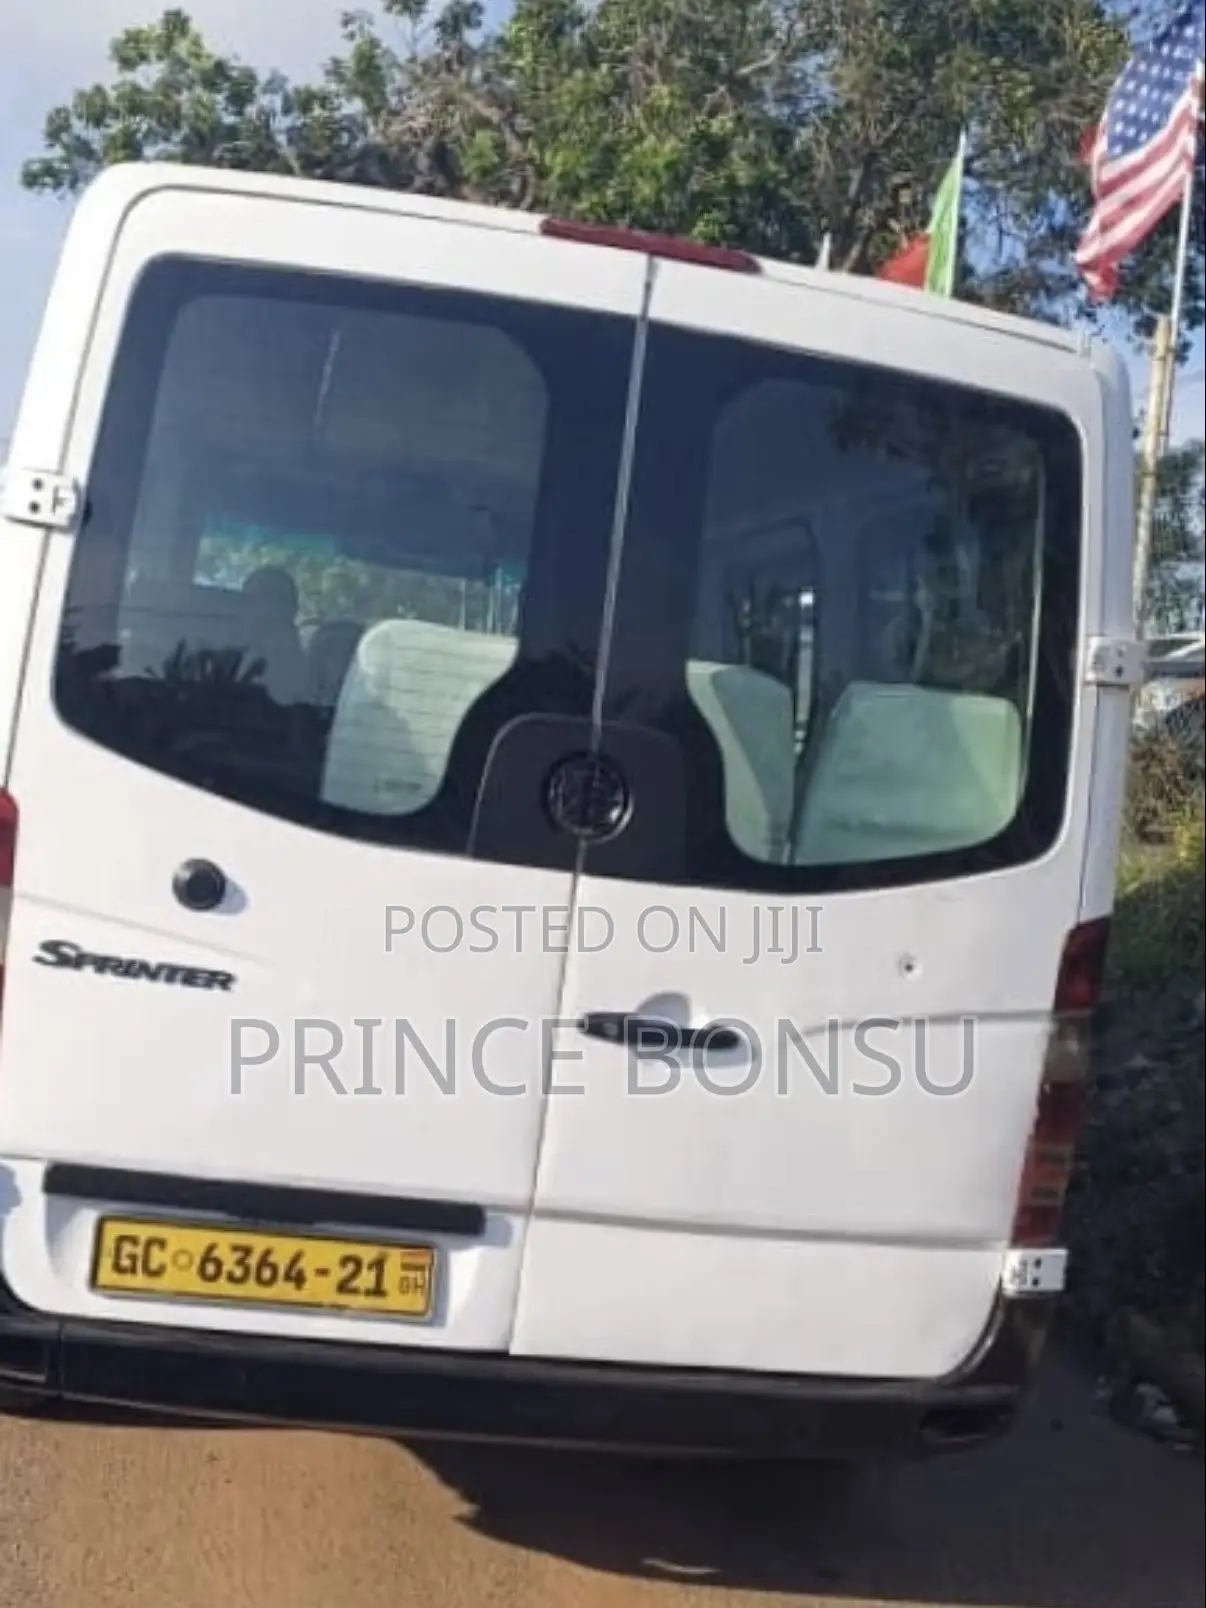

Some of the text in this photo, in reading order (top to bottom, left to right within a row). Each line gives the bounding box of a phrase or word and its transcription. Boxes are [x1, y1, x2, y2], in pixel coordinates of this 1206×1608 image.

[32, 939, 238, 992] SPRINTER
[111, 1234, 391, 1298] GC 6364-21
